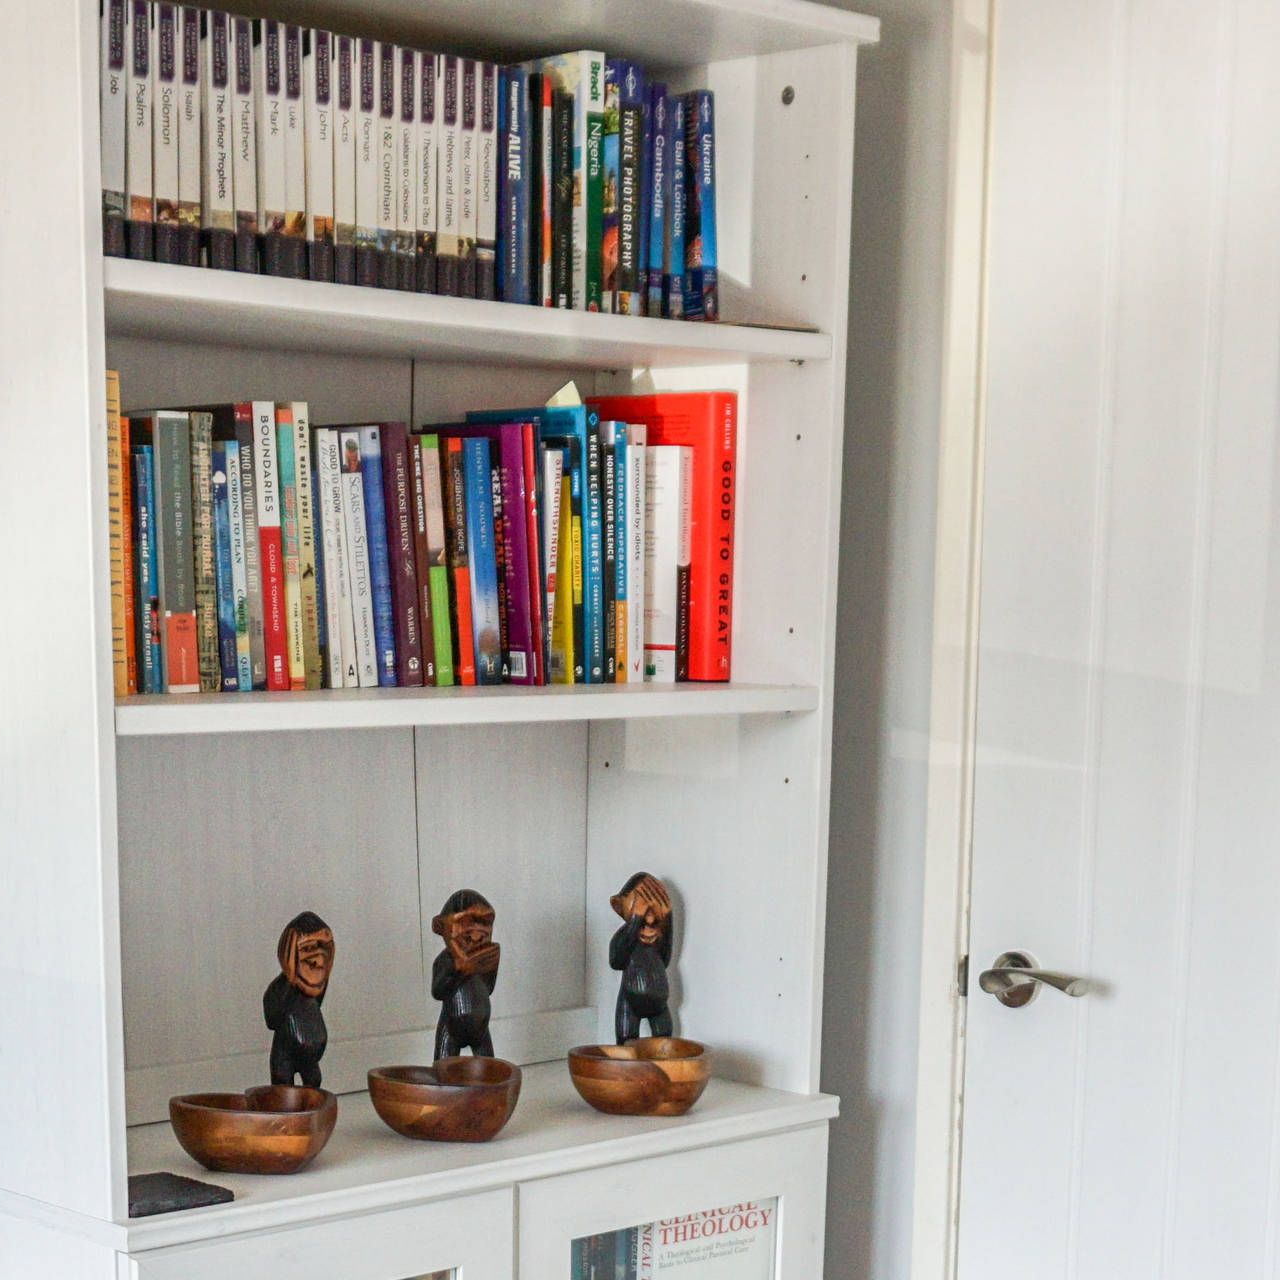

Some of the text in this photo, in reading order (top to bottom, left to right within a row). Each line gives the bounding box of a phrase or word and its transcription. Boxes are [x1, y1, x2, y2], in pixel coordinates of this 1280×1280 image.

[110, 75, 119, 94] Job
[590, 61, 601, 101] Bradt
[136, 83, 146, 127] Psalms
[162, 87, 172, 145] Solomon
[185, 91, 193, 121] Isaiah
[270, 101, 279, 136] Mark
[288, 106, 297, 129] Luke
[319, 110, 329, 140] John
[217, 94, 227, 199] The Minor Prophets
[241, 101, 251, 161] Matthew
[341, 115, 350, 143] Acts
[363, 118, 372, 162] Romans
[508, 81, 520, 180] Dangerously ALIVE
[589, 122, 601, 176] Nigeria
[423, 138, 431, 194] Thessalonians
[445, 131, 455, 227] Hebrews and James
[483, 138, 492, 202] Revelation
[654, 135, 664, 218] Cambodia
[702, 134, 712, 184] Ukraine
[383, 153, 393, 221] Corinthians
[623, 110, 633, 269] TRAVEL PHOTOGRAPHY
[673, 141, 683, 237] Bali & Lombok
[423, 207, 431, 225] Titus
[241, 446, 251, 470] WHO
[243, 473, 252, 487] DO
[261, 415, 273, 513] BOUNDARIES
[328, 444, 342, 513] GOOD TO GROW
[175, 492, 183, 508] the
[244, 491, 254, 510] YOU
[298, 419, 311, 547] don't waste your life
[396, 468, 408, 513] PURPOSE
[454, 469, 462, 512] JOURNEYS
[492, 469, 502, 517] REAL
[590, 435, 600, 573] WHEN HELPING HURTS
[175, 512, 183, 536] Bible
[200, 506, 210, 528] FOR
[230, 459, 242, 564] ACCORDING TO PLAN
[245, 513, 256, 542] THINK
[399, 515, 409, 551] DRIVEN
[457, 515, 462, 524] OF
[549, 459, 562, 568] STRENGTHSFINDER
[633, 518, 641, 531] by
[140, 507, 149, 583] she said yes
[247, 546, 256, 565] YOU
[268, 544, 277, 573] CLOUD
[349, 477, 368, 597] SCARS AND STILETTOS
[717, 460, 731, 645] GOOD TO GREAT
[271, 585, 280, 631] TOWNSEND
[407, 607, 415, 644] WARREN
[143, 604, 153, 668] Misty Bernall
[659, 1209, 772, 1245] THEOLOGY
